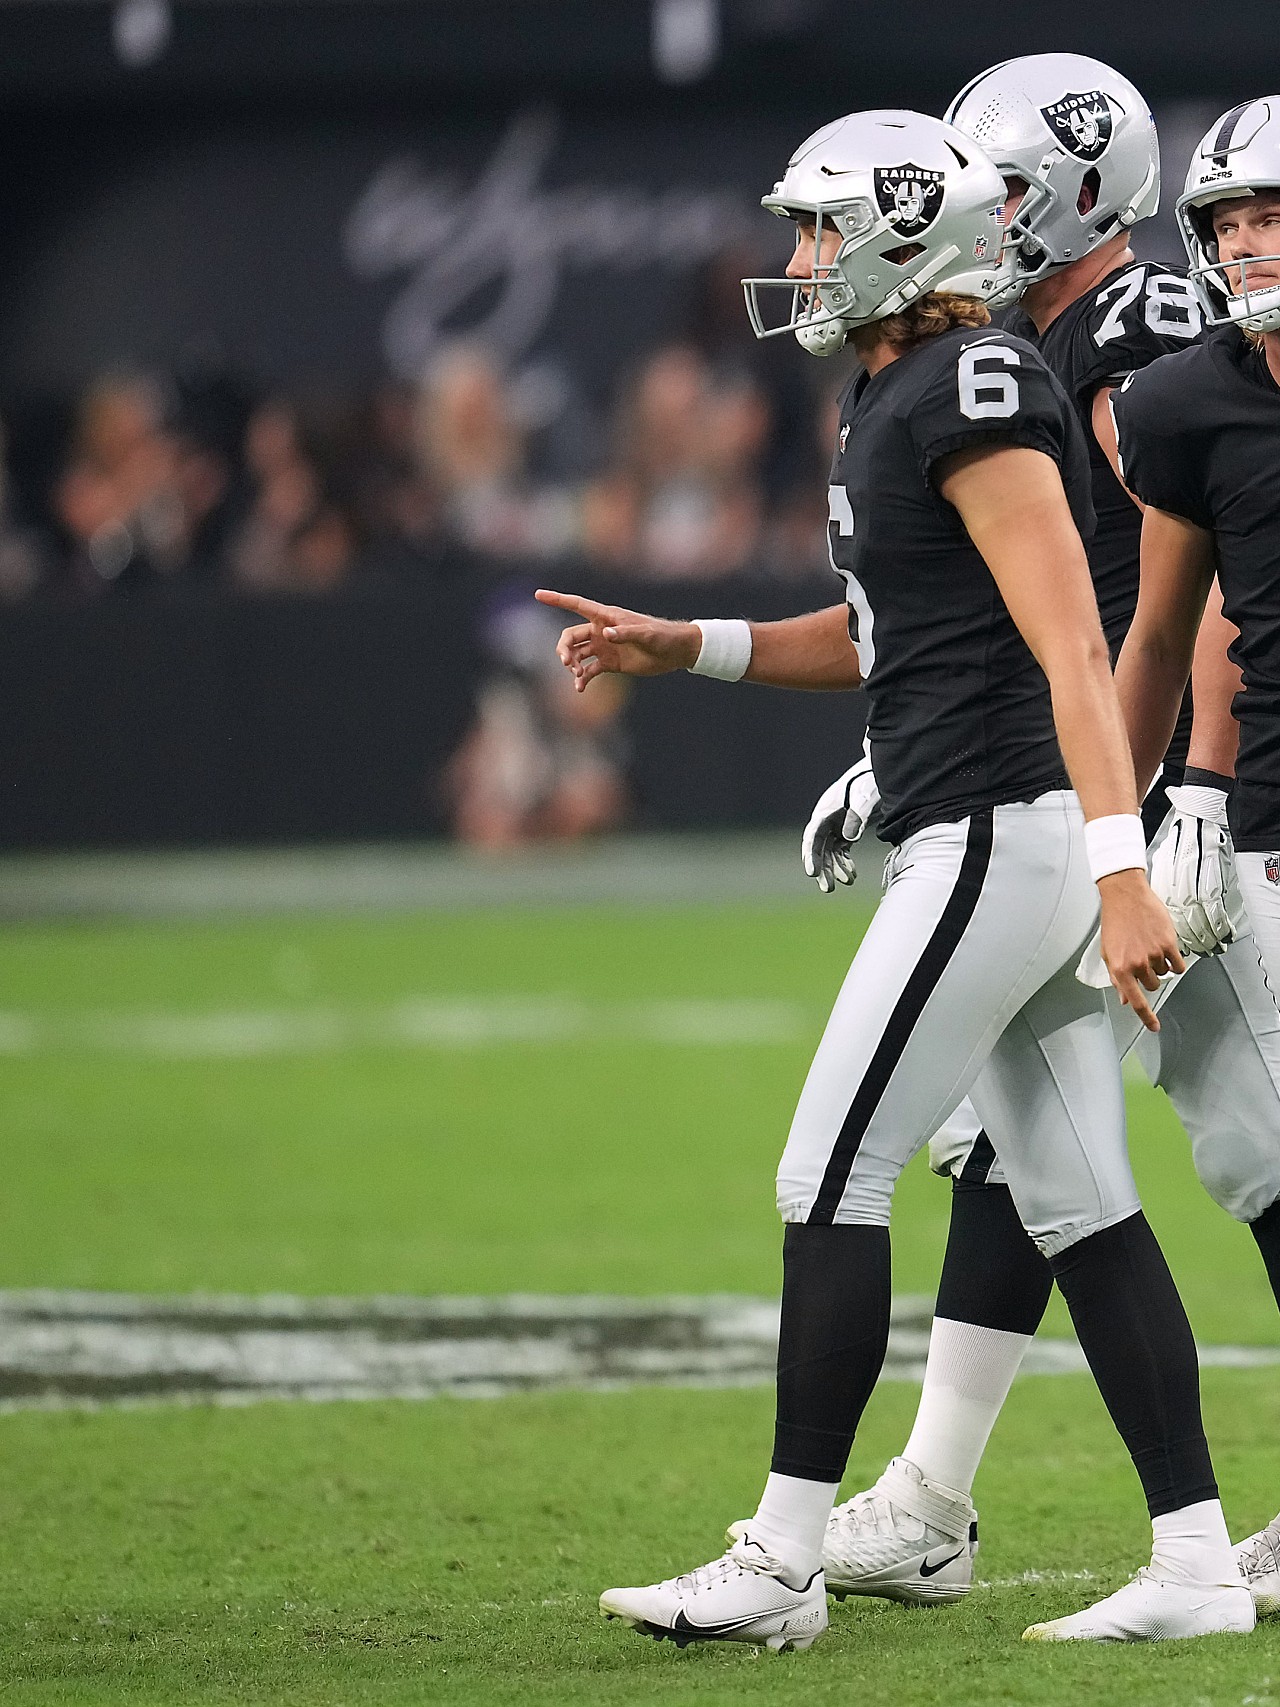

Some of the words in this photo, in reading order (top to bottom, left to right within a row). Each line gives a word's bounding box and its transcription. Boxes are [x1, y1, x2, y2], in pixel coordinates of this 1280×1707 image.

[1047, 91, 1100, 116] RAIDERS
[880, 169, 940, 181] RAIDERS
[1092, 265, 1202, 348] 78
[957, 344, 1021, 421] 6
